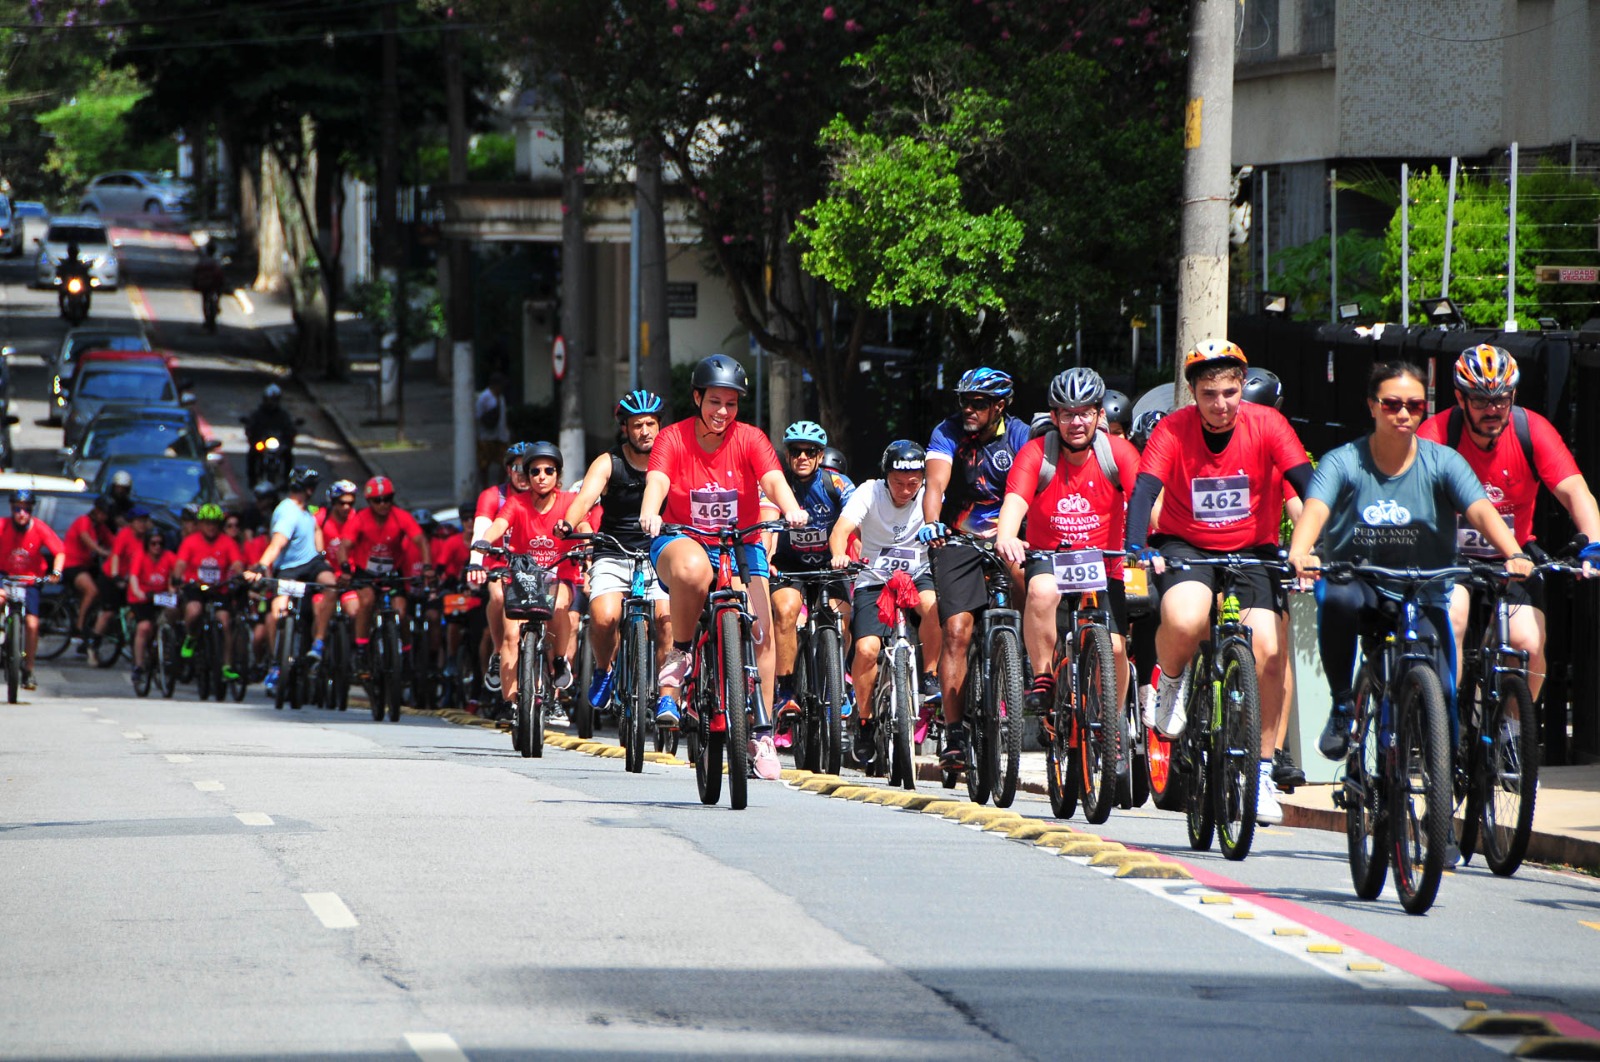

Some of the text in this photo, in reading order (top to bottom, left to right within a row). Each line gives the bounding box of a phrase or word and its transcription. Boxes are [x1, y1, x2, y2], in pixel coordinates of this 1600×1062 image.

[1201, 491, 1242, 510] 462
[698, 503, 732, 518] 465
[1050, 514, 1100, 525] PEDALANDO
[796, 532, 821, 542] 501
[1062, 532, 1090, 542] 2025
[1353, 527, 1419, 537] PEDALANDO
[1352, 536, 1377, 546] COM
[1378, 536, 1388, 544] O
[880, 557, 910, 572] 299
[1061, 565, 1099, 582] 498
